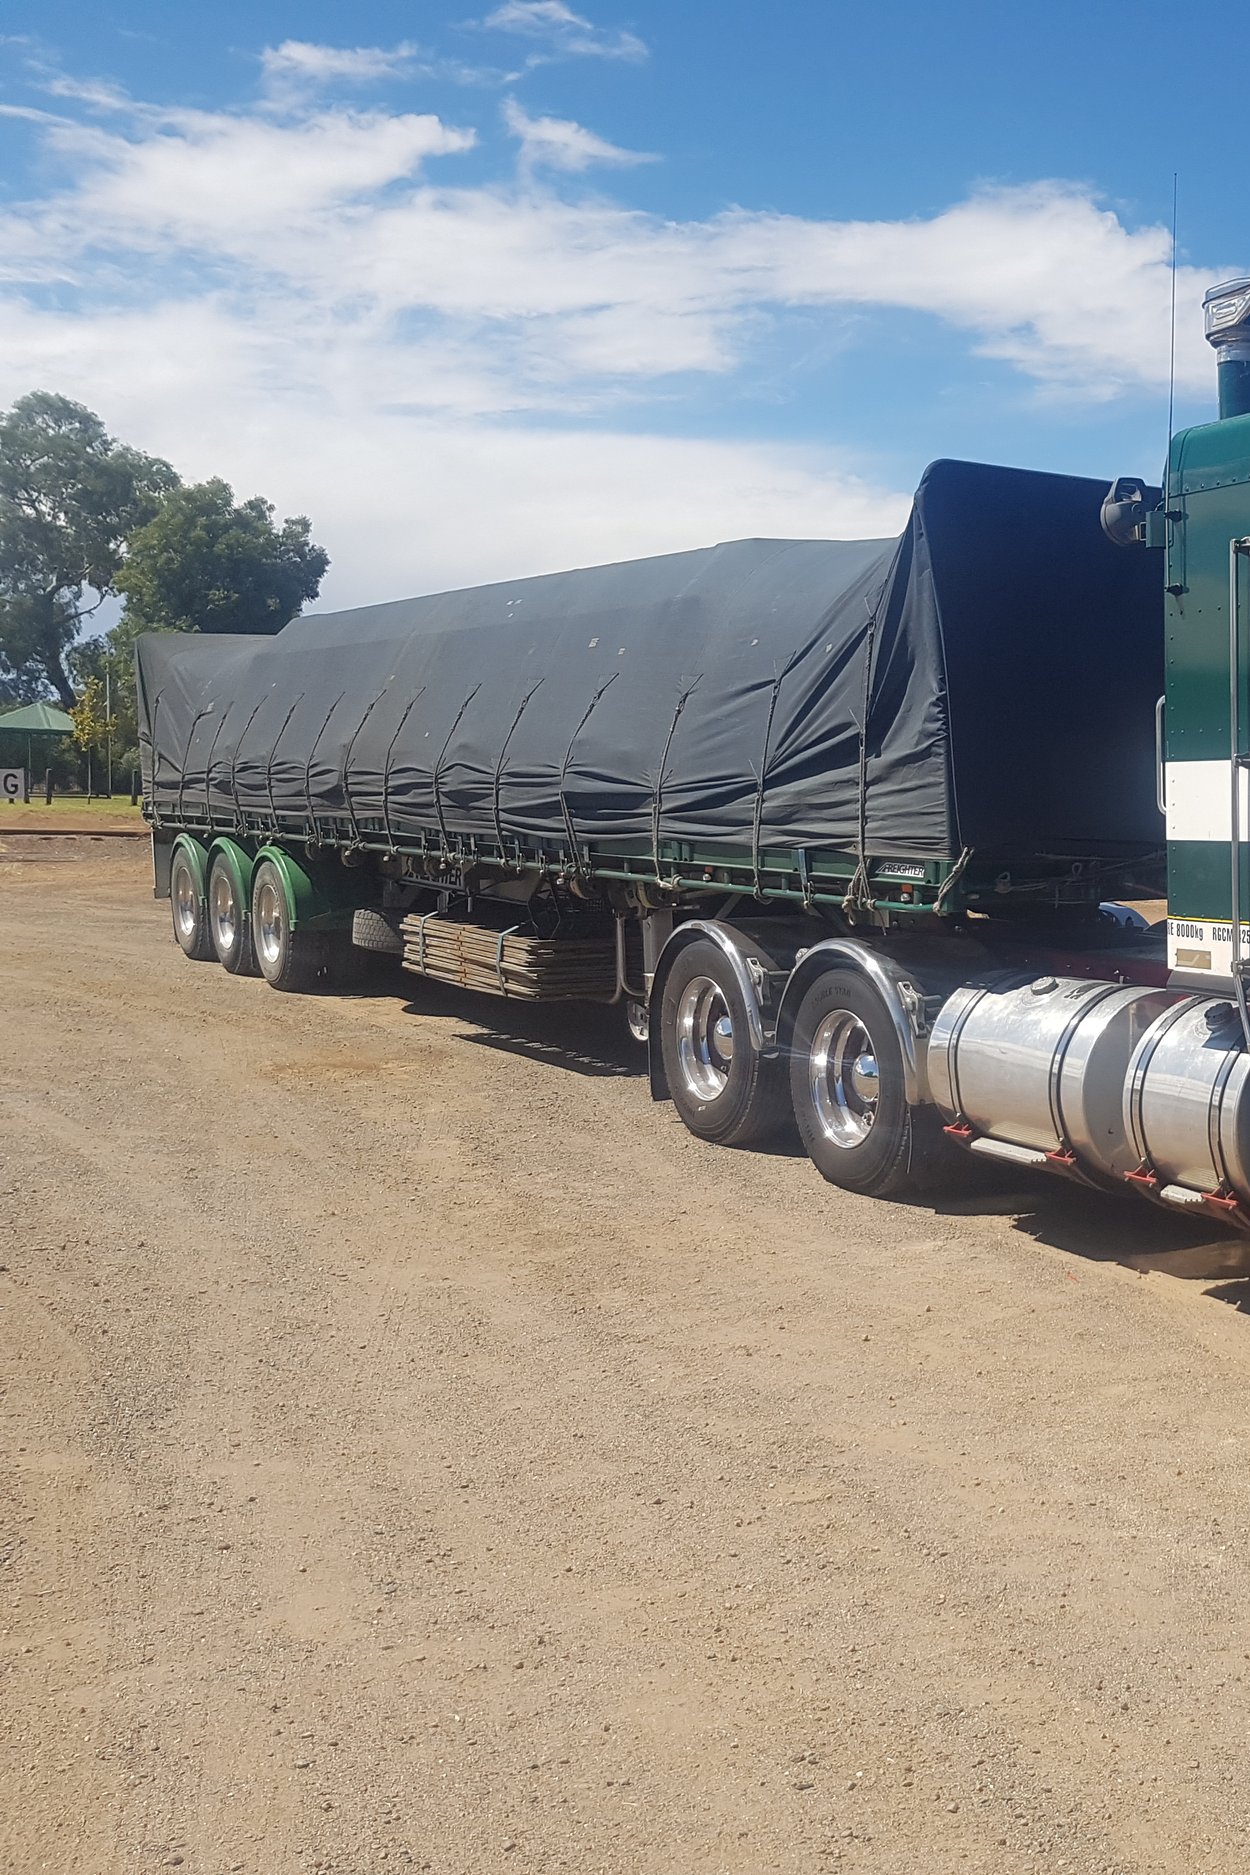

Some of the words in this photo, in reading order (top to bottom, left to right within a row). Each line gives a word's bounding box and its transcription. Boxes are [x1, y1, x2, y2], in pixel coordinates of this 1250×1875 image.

[3, 773, 18, 795] G
[881, 863, 925, 877] FREIGHTER
[1176, 923, 1204, 941] 8000kg
